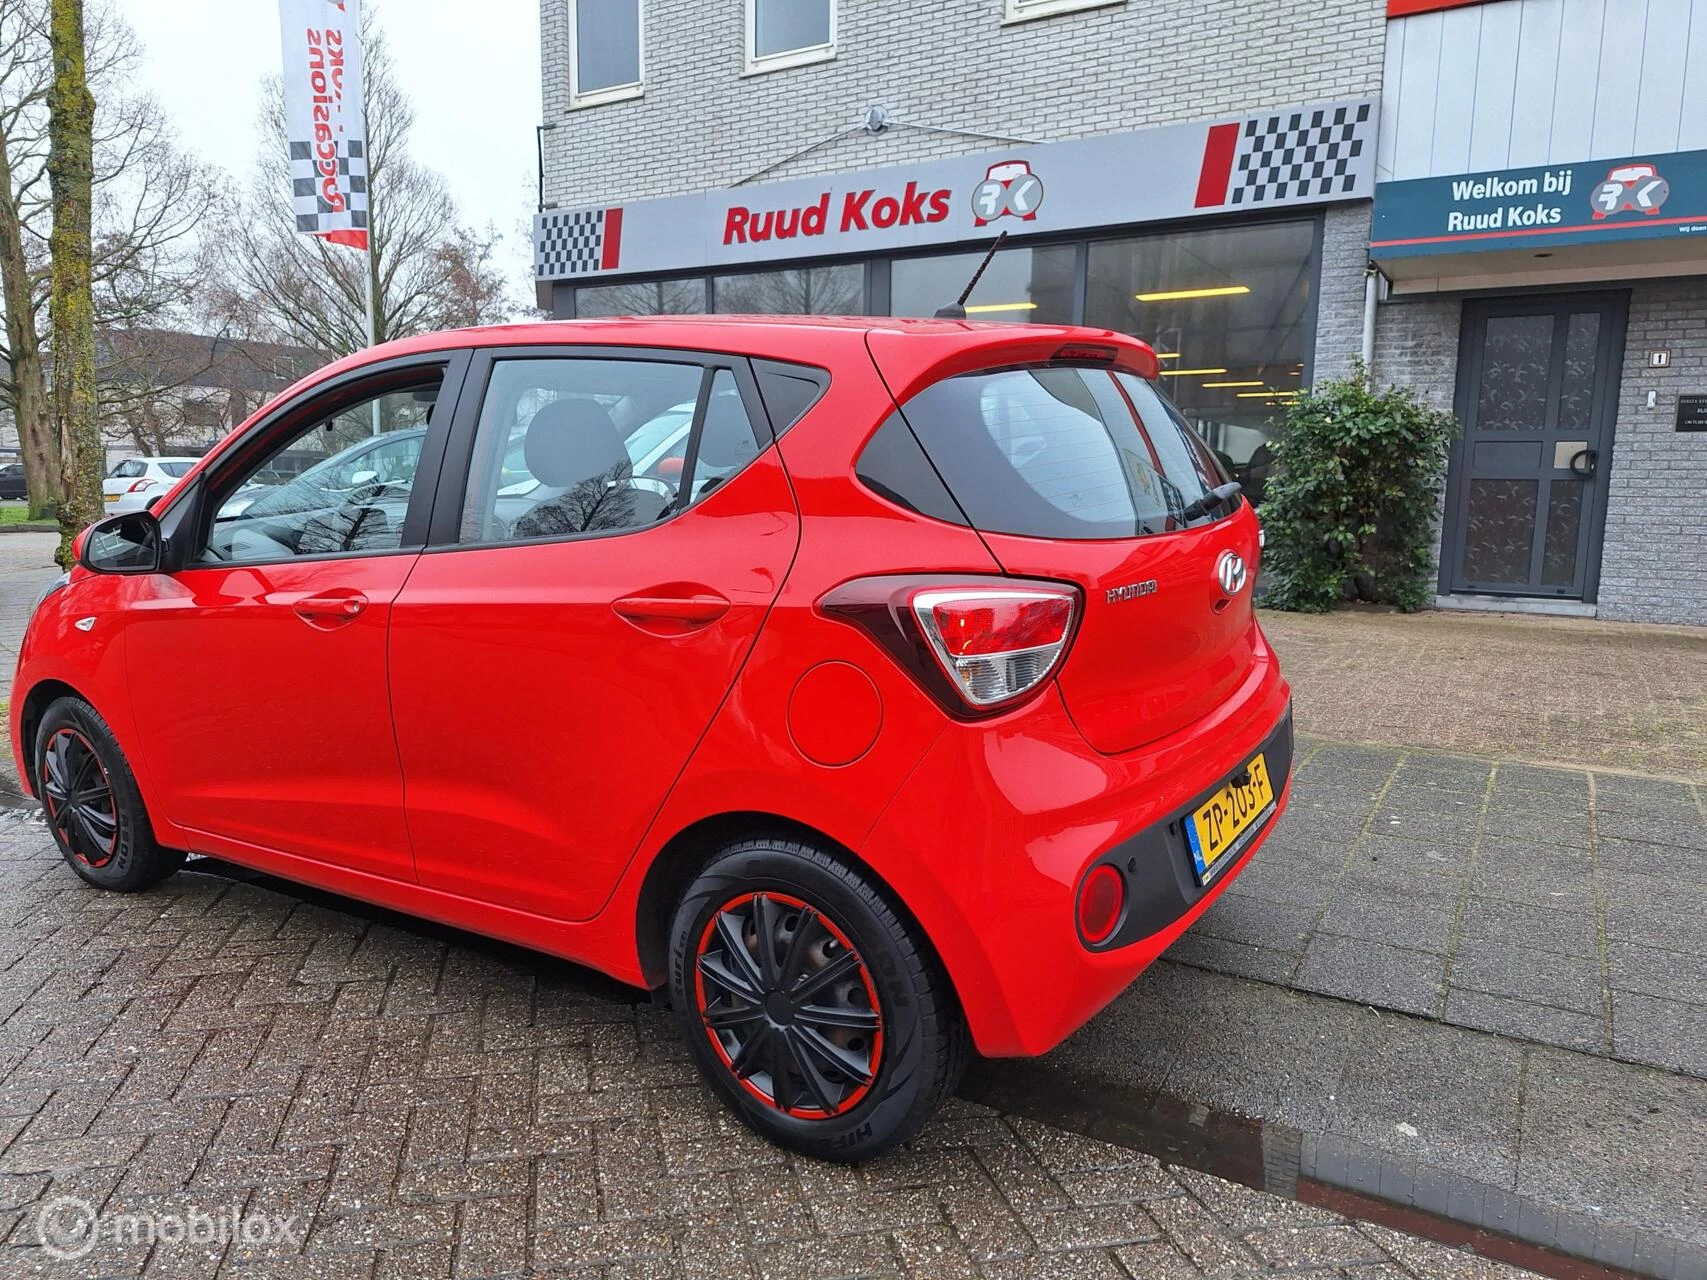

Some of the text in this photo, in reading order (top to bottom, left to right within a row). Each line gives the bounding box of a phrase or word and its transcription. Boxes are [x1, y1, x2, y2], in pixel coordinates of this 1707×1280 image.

[1452, 170, 1572, 201] Welkom bij
[723, 181, 952, 245] Ruud Koks
[1447, 205, 1562, 232] Ruud Koks
